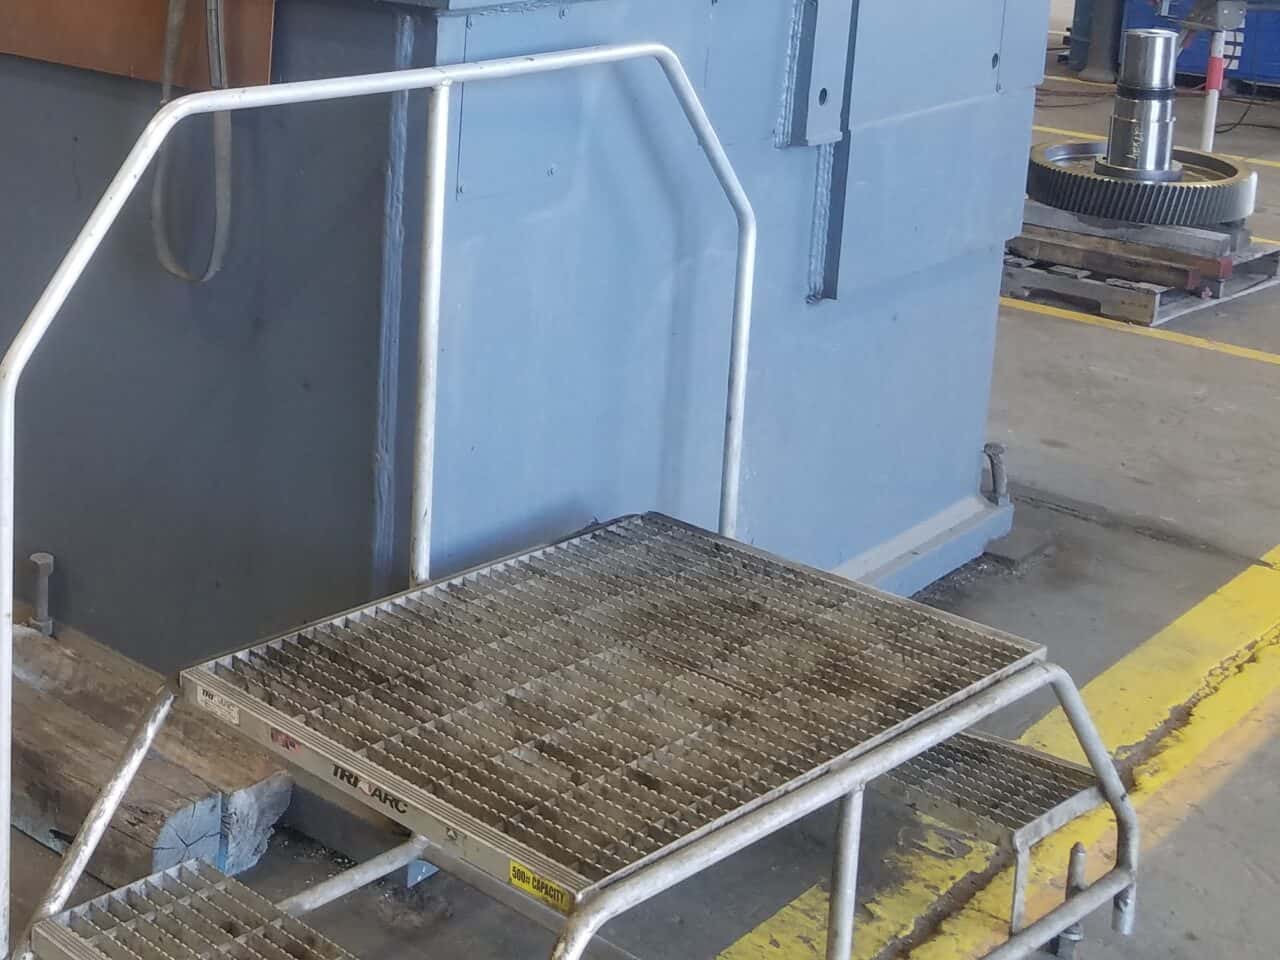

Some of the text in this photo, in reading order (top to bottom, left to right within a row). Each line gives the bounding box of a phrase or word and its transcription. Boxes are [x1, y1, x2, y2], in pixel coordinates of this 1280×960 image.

[333, 764, 408, 814] TRI ARC
[531, 876, 564, 904] CAPACITY
